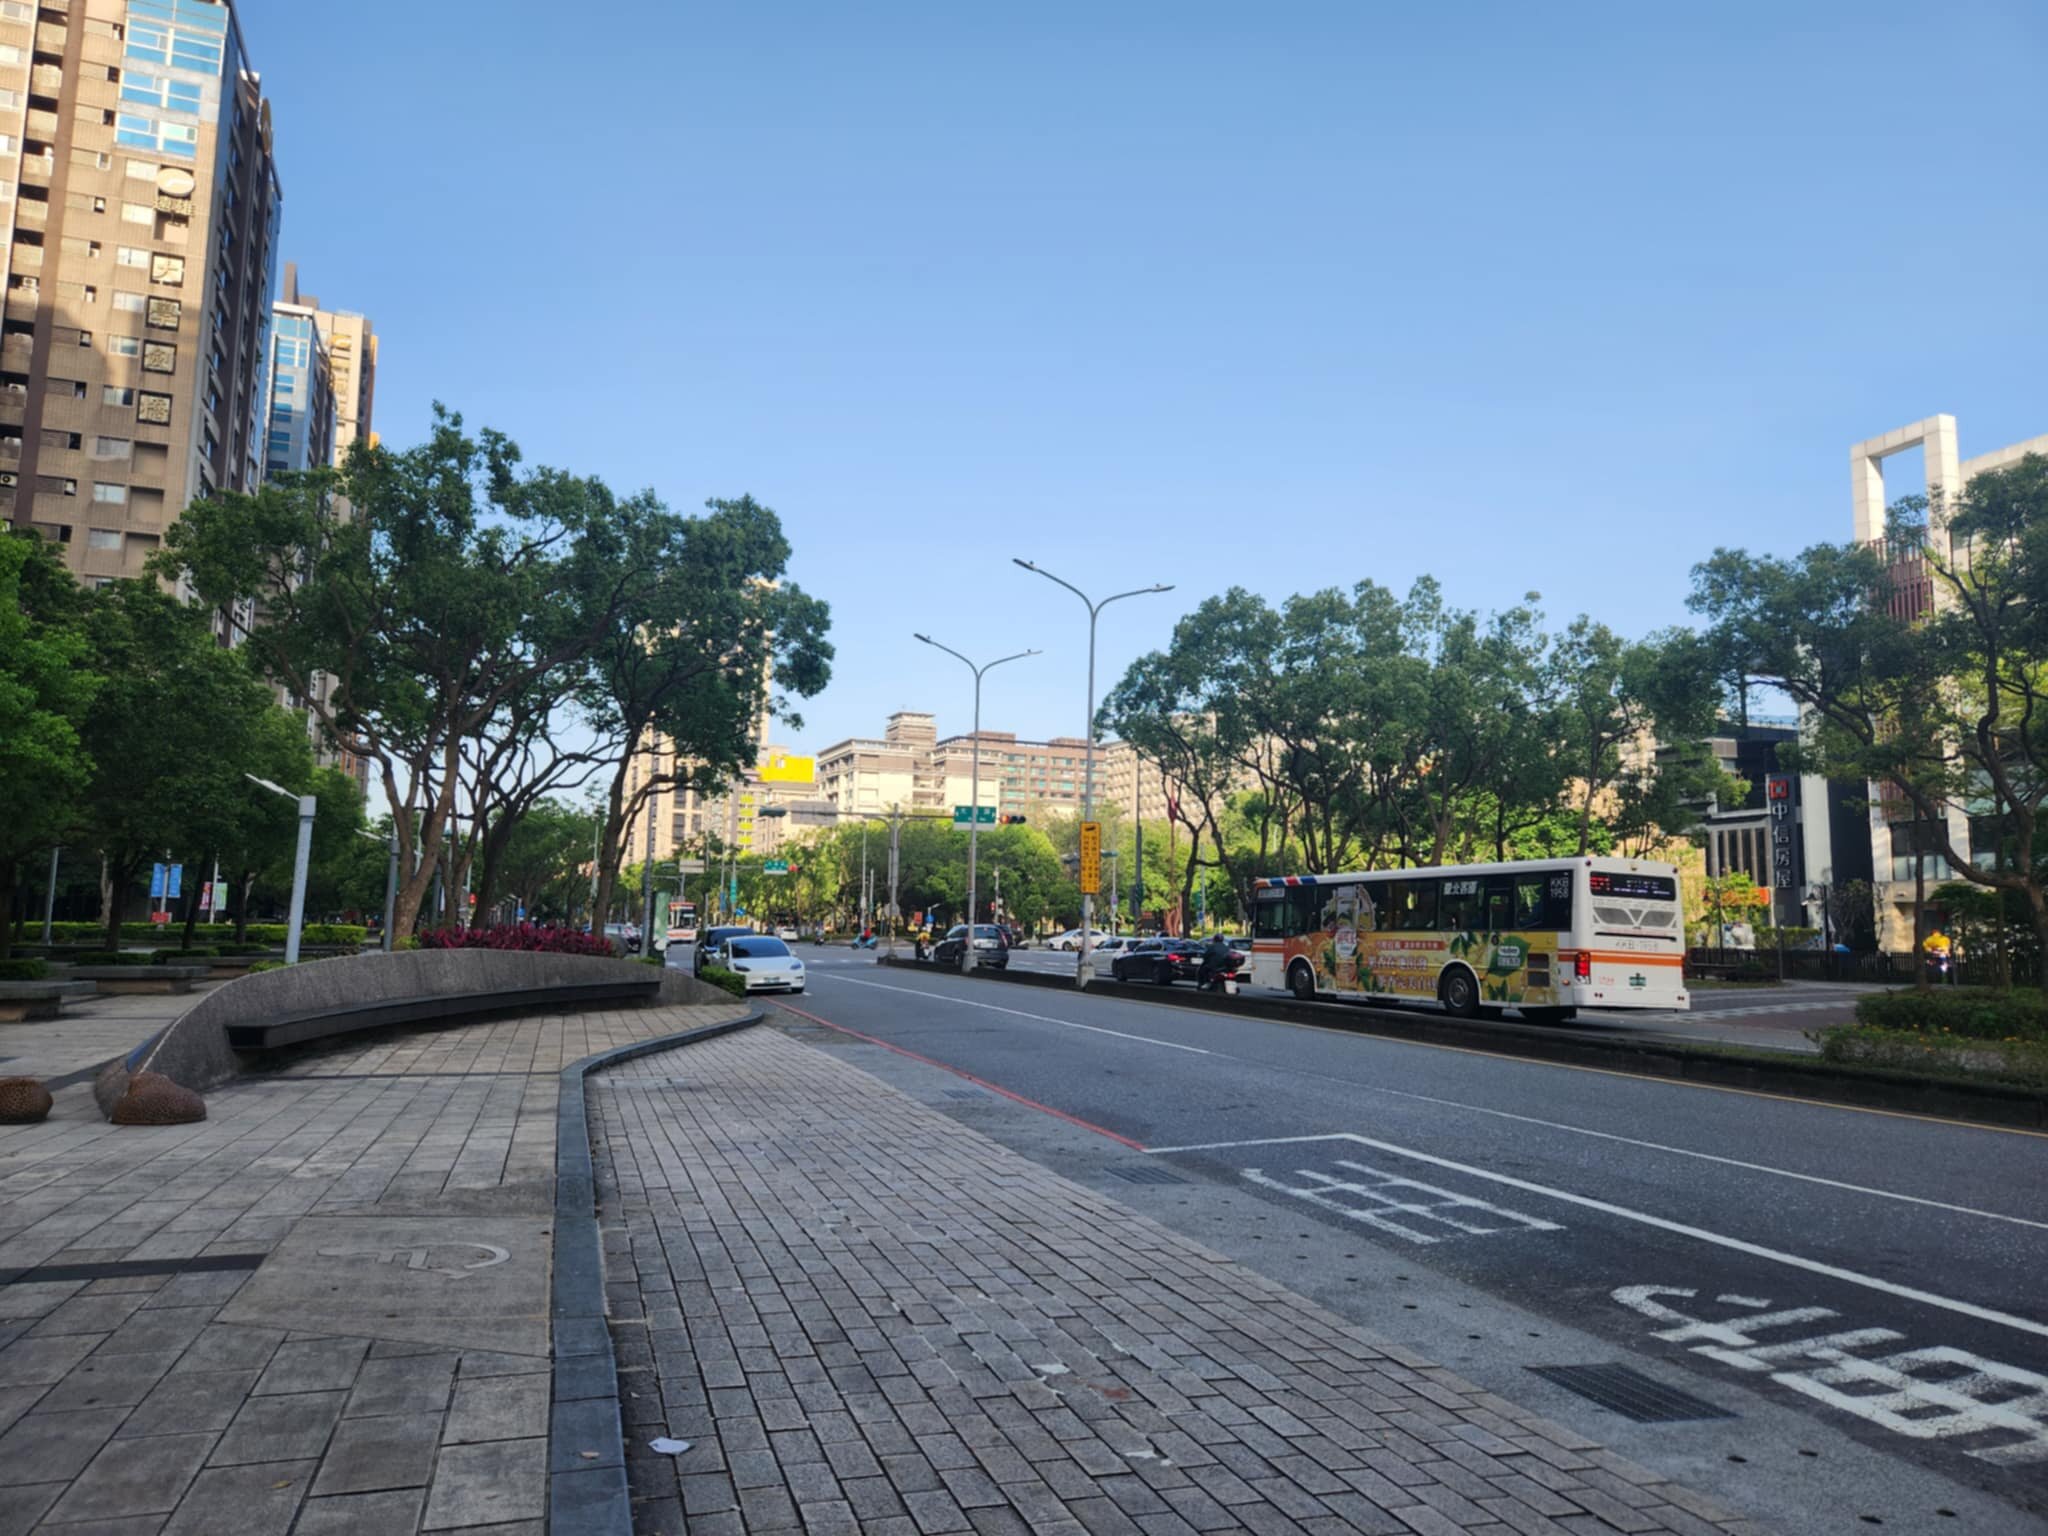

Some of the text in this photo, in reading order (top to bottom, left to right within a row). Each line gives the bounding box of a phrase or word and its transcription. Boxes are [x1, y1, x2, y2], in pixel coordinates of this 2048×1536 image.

[1772, 802, 1792, 888] 中信房屋
[1550, 877, 1569, 888] KKB
